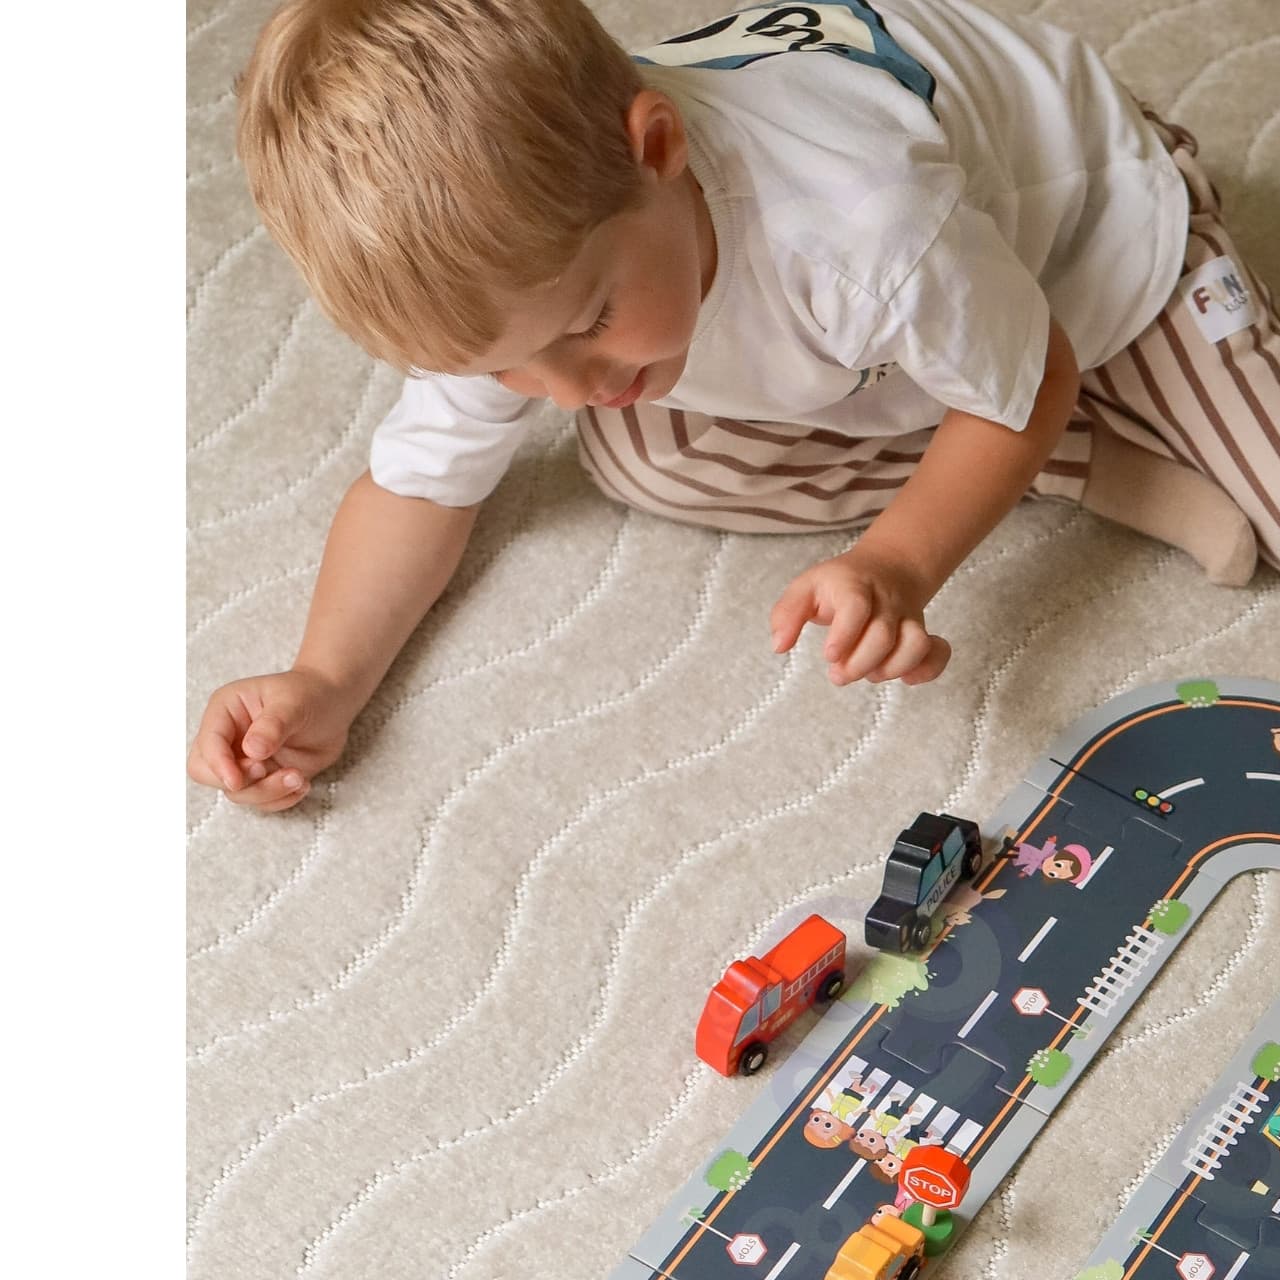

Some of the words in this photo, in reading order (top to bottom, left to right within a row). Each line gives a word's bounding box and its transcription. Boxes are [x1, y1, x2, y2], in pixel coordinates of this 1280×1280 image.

[926, 866, 958, 911] POLICE
[1022, 992, 1041, 1012] STOP
[910, 1176, 951, 1197] STOP
[738, 1238, 757, 1260] STOP
[1188, 1257, 1205, 1279] STOP
